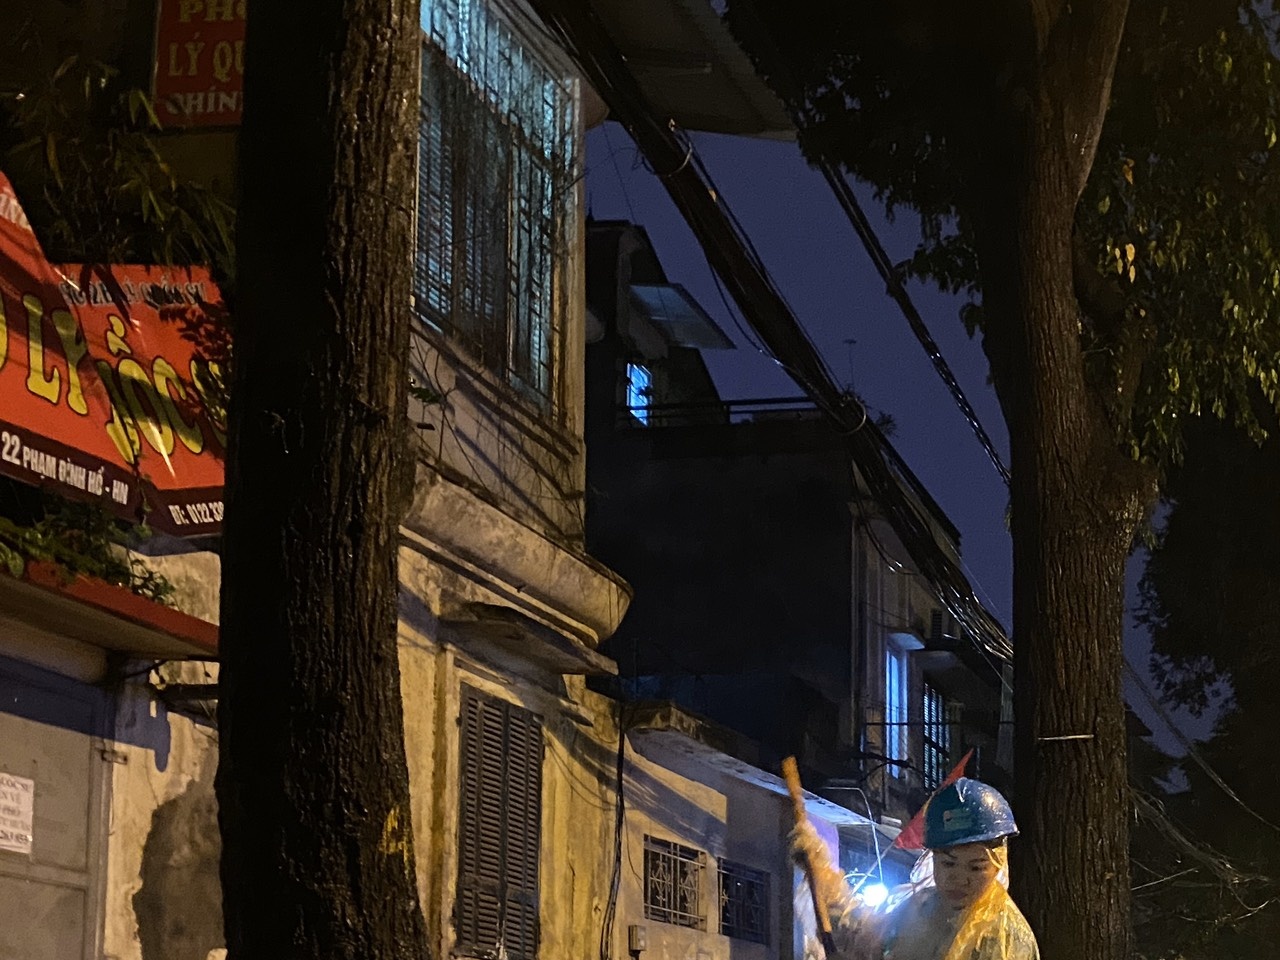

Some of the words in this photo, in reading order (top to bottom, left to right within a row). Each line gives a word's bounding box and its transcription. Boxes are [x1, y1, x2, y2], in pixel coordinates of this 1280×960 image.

[168, 31, 205, 76] LÝ
[165, 86, 244, 114] CHÍN
[2, 431, 21, 466] 22
[22, 445, 57, 479] PHẠM
[111, 479, 129, 505] HN
